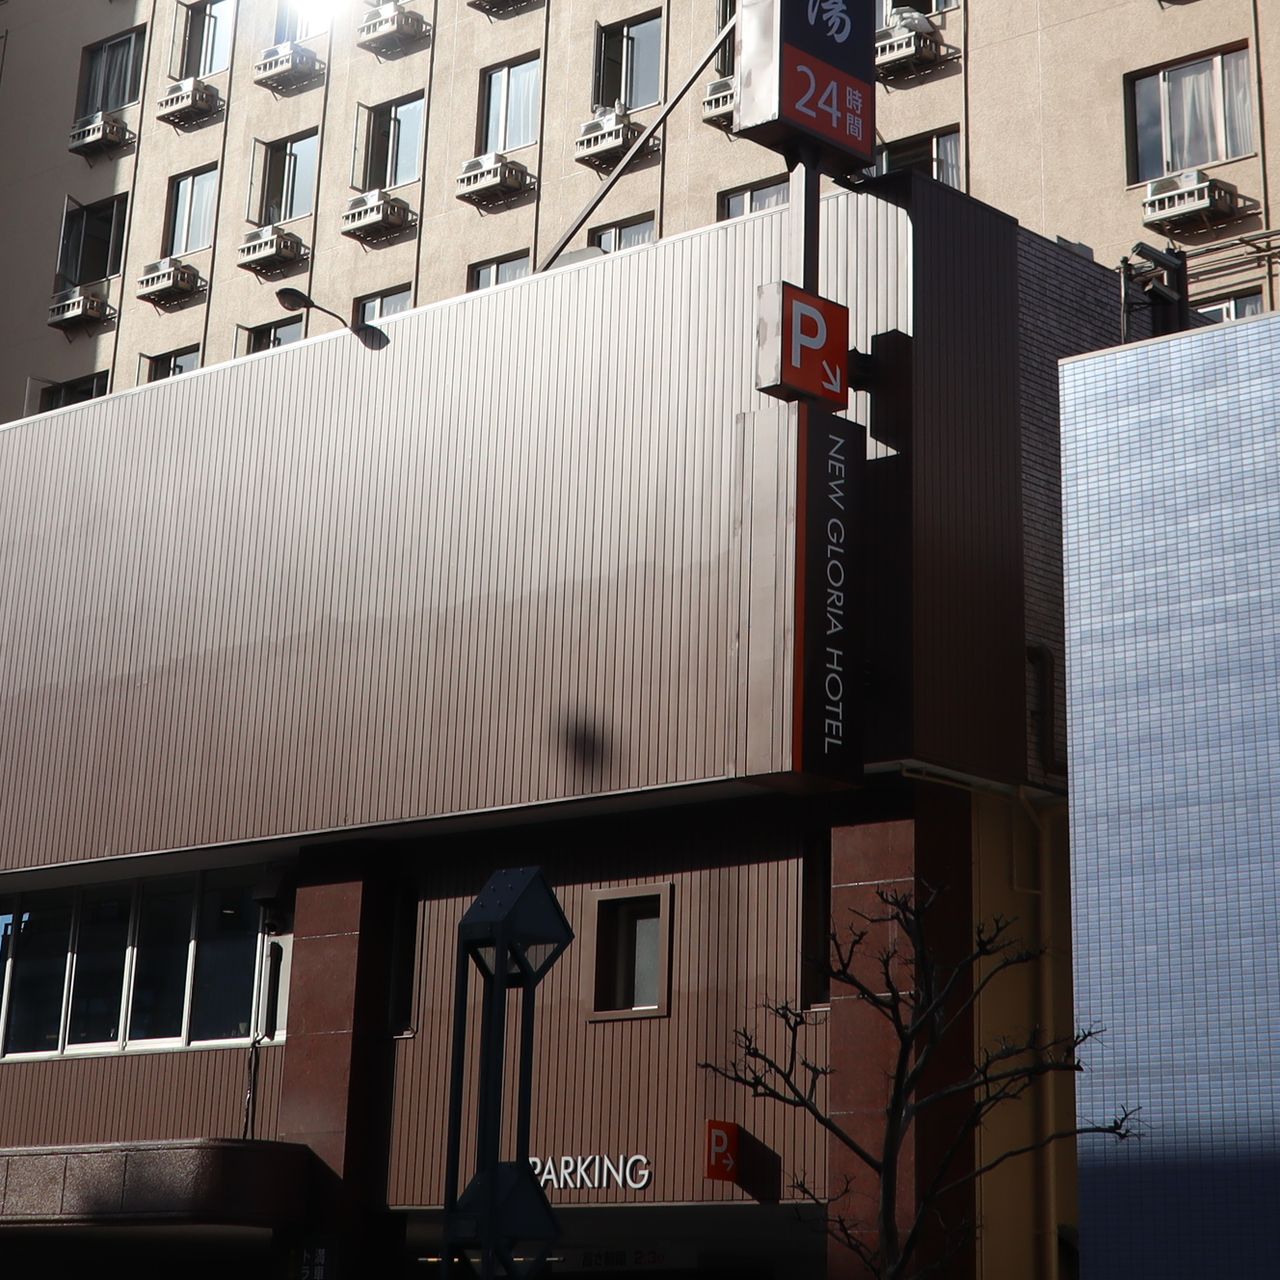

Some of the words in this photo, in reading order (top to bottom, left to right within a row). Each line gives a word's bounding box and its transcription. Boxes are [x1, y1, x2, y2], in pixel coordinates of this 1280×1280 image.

[791, 299, 827, 369] P
[826, 434, 846, 510] NEW
[826, 518, 846, 637] GLORIA
[824, 647, 846, 755] HOTEL
[528, 1154, 650, 1190] PARKING
[710, 1128, 729, 1166] P
